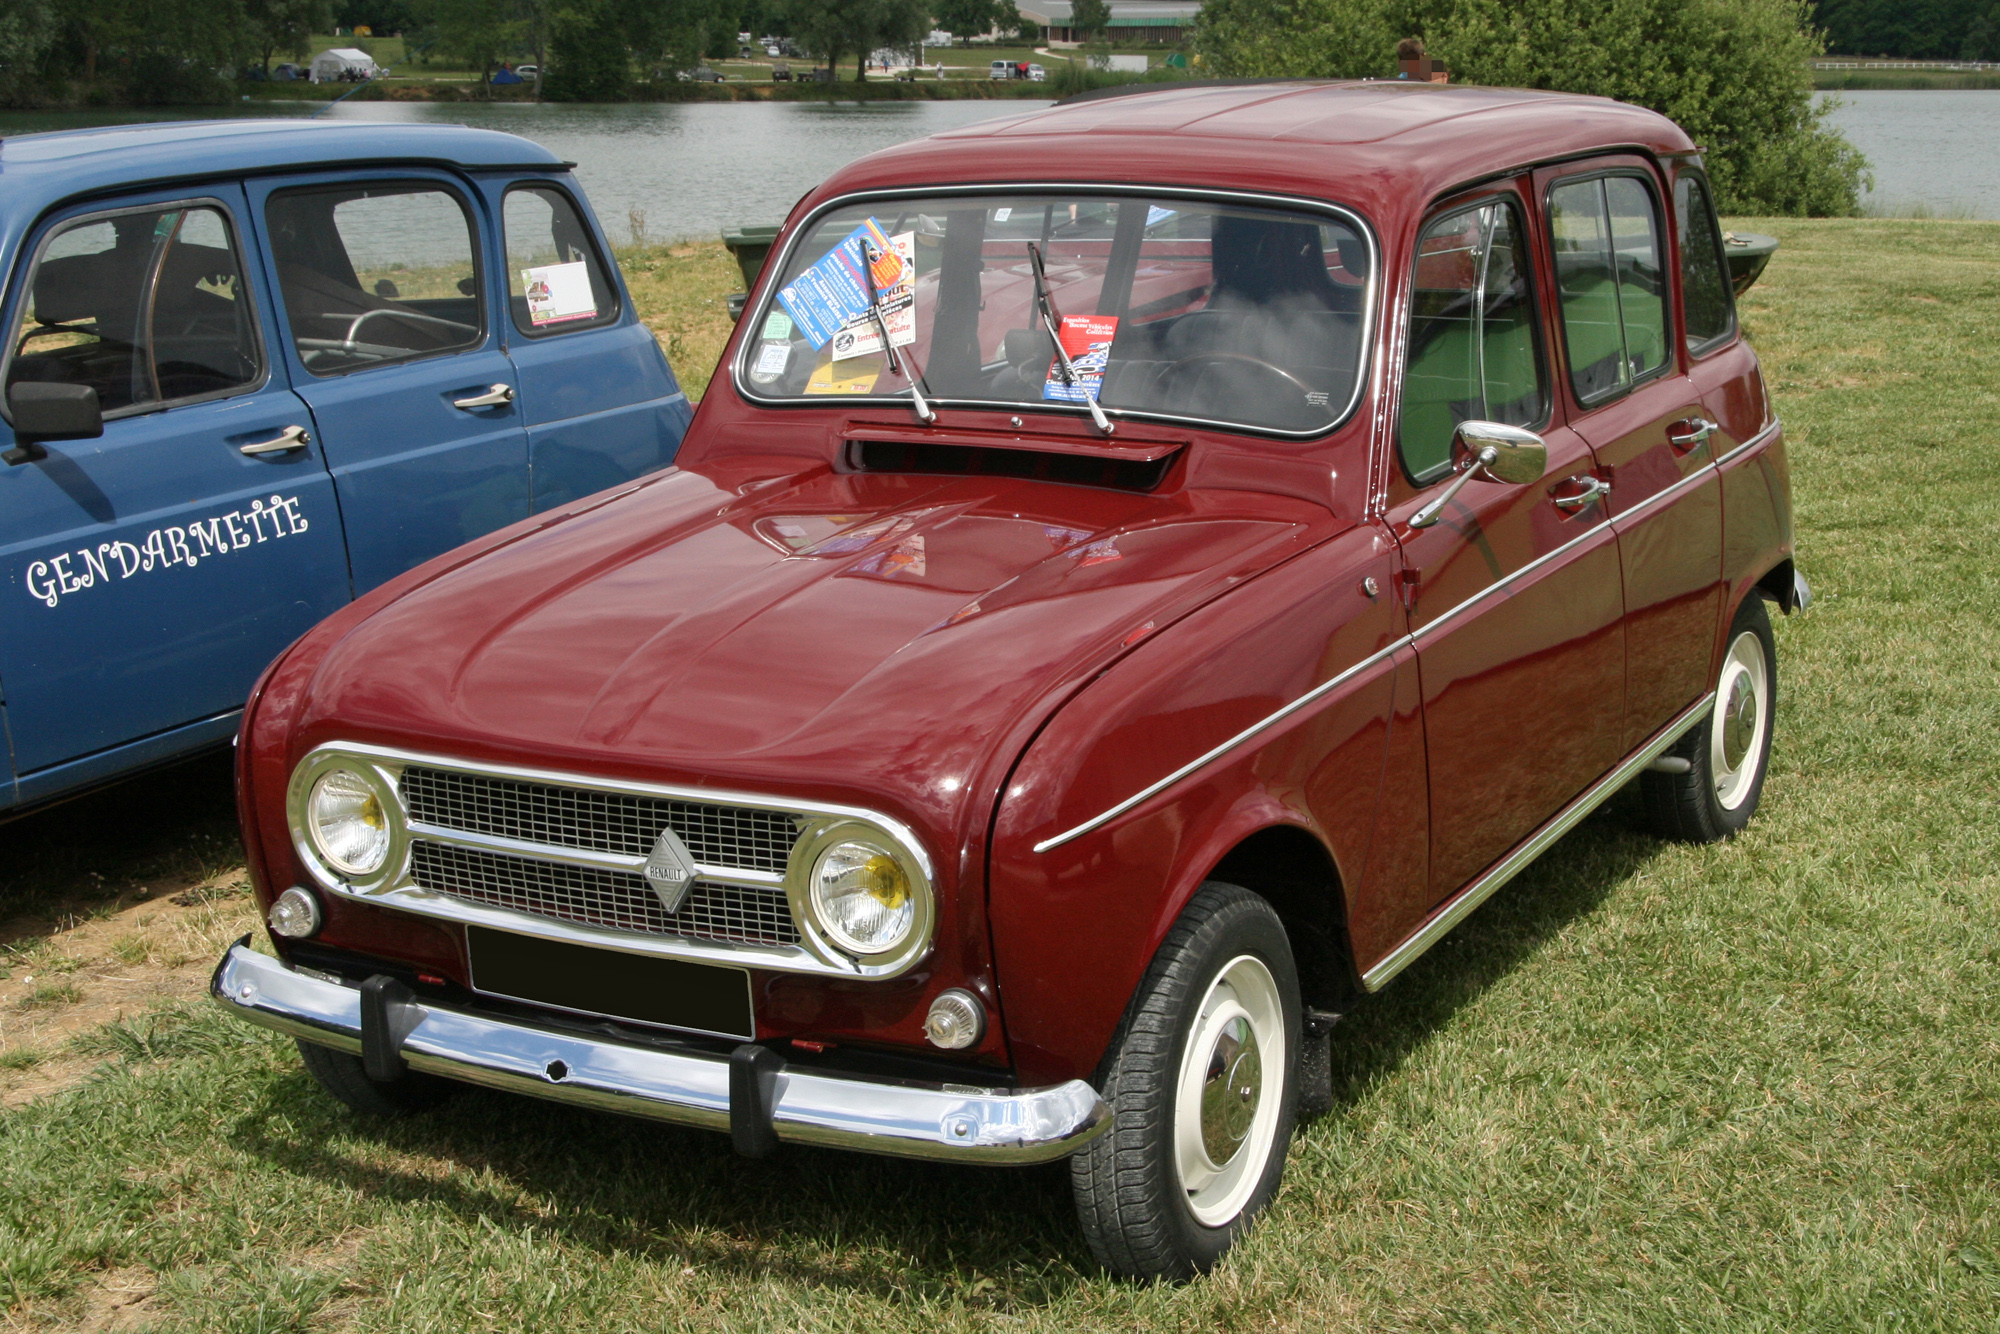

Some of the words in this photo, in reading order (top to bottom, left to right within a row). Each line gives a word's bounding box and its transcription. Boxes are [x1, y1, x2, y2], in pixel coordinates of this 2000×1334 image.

[842, 241, 864, 267] Spécialiste
[847, 236, 860, 251] Votre
[829, 252, 845, 271] proche
[842, 269, 851, 279] de
[848, 276, 860, 291] chez
[809, 276, 829, 301] Yvonnick
[825, 299, 842, 320] BLAISE
[818, 278, 841, 309] Assurances
[26, 494, 309, 608] GENDARMETTE
[649, 866, 682, 881] RENAULT
